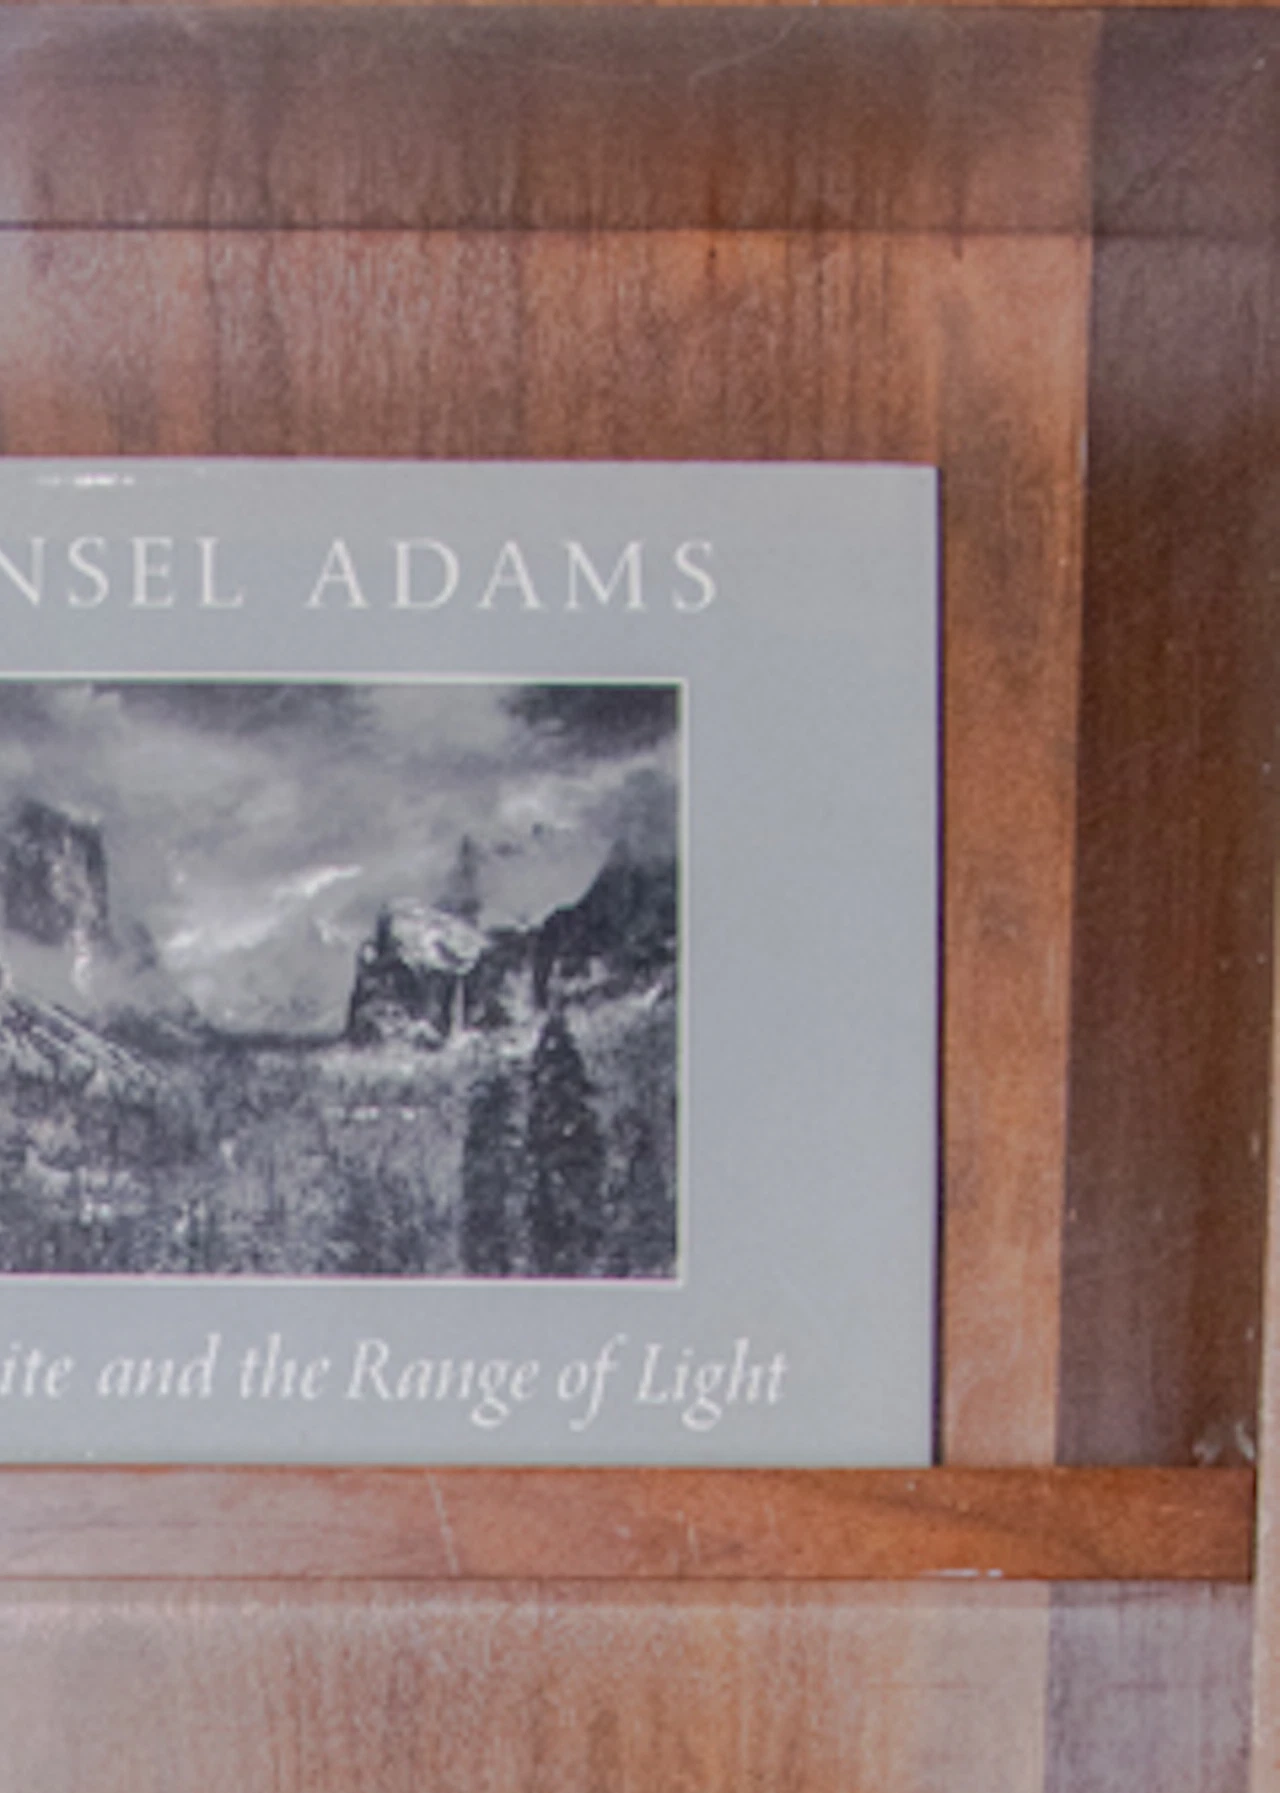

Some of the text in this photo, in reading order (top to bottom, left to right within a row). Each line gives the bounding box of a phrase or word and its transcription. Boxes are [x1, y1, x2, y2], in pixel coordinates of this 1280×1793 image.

[306, 538, 721, 614] ADAMS
[96, 1333, 218, 1399] and
[237, 1334, 330, 1399] the
[345, 1339, 539, 1428] Range
[558, 1333, 628, 1430] of
[636, 1339, 789, 1430] Light
